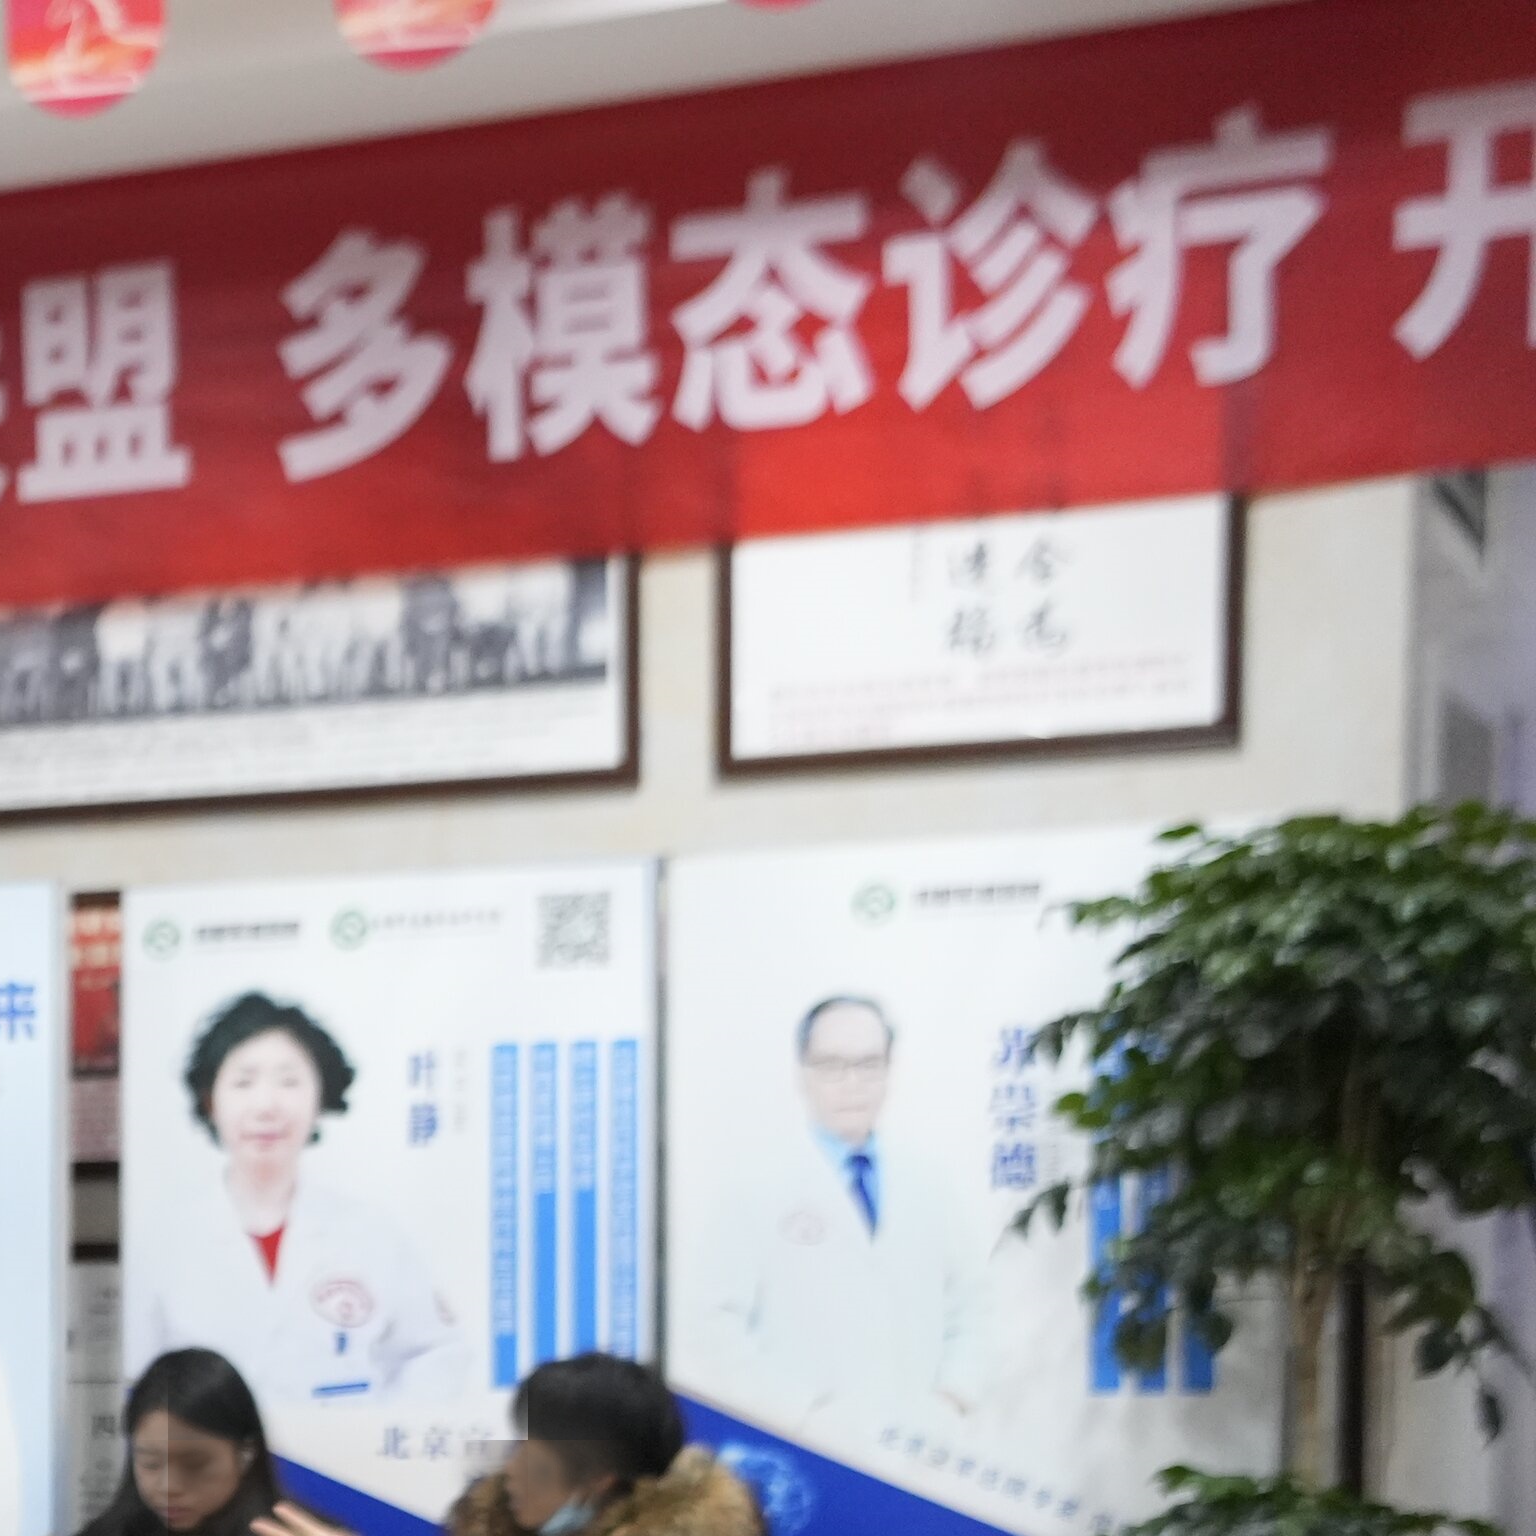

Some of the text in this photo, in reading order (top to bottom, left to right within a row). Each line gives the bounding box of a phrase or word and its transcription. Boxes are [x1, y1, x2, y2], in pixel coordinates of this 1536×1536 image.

[279, 105, 1334, 482] 多模态诊疗
